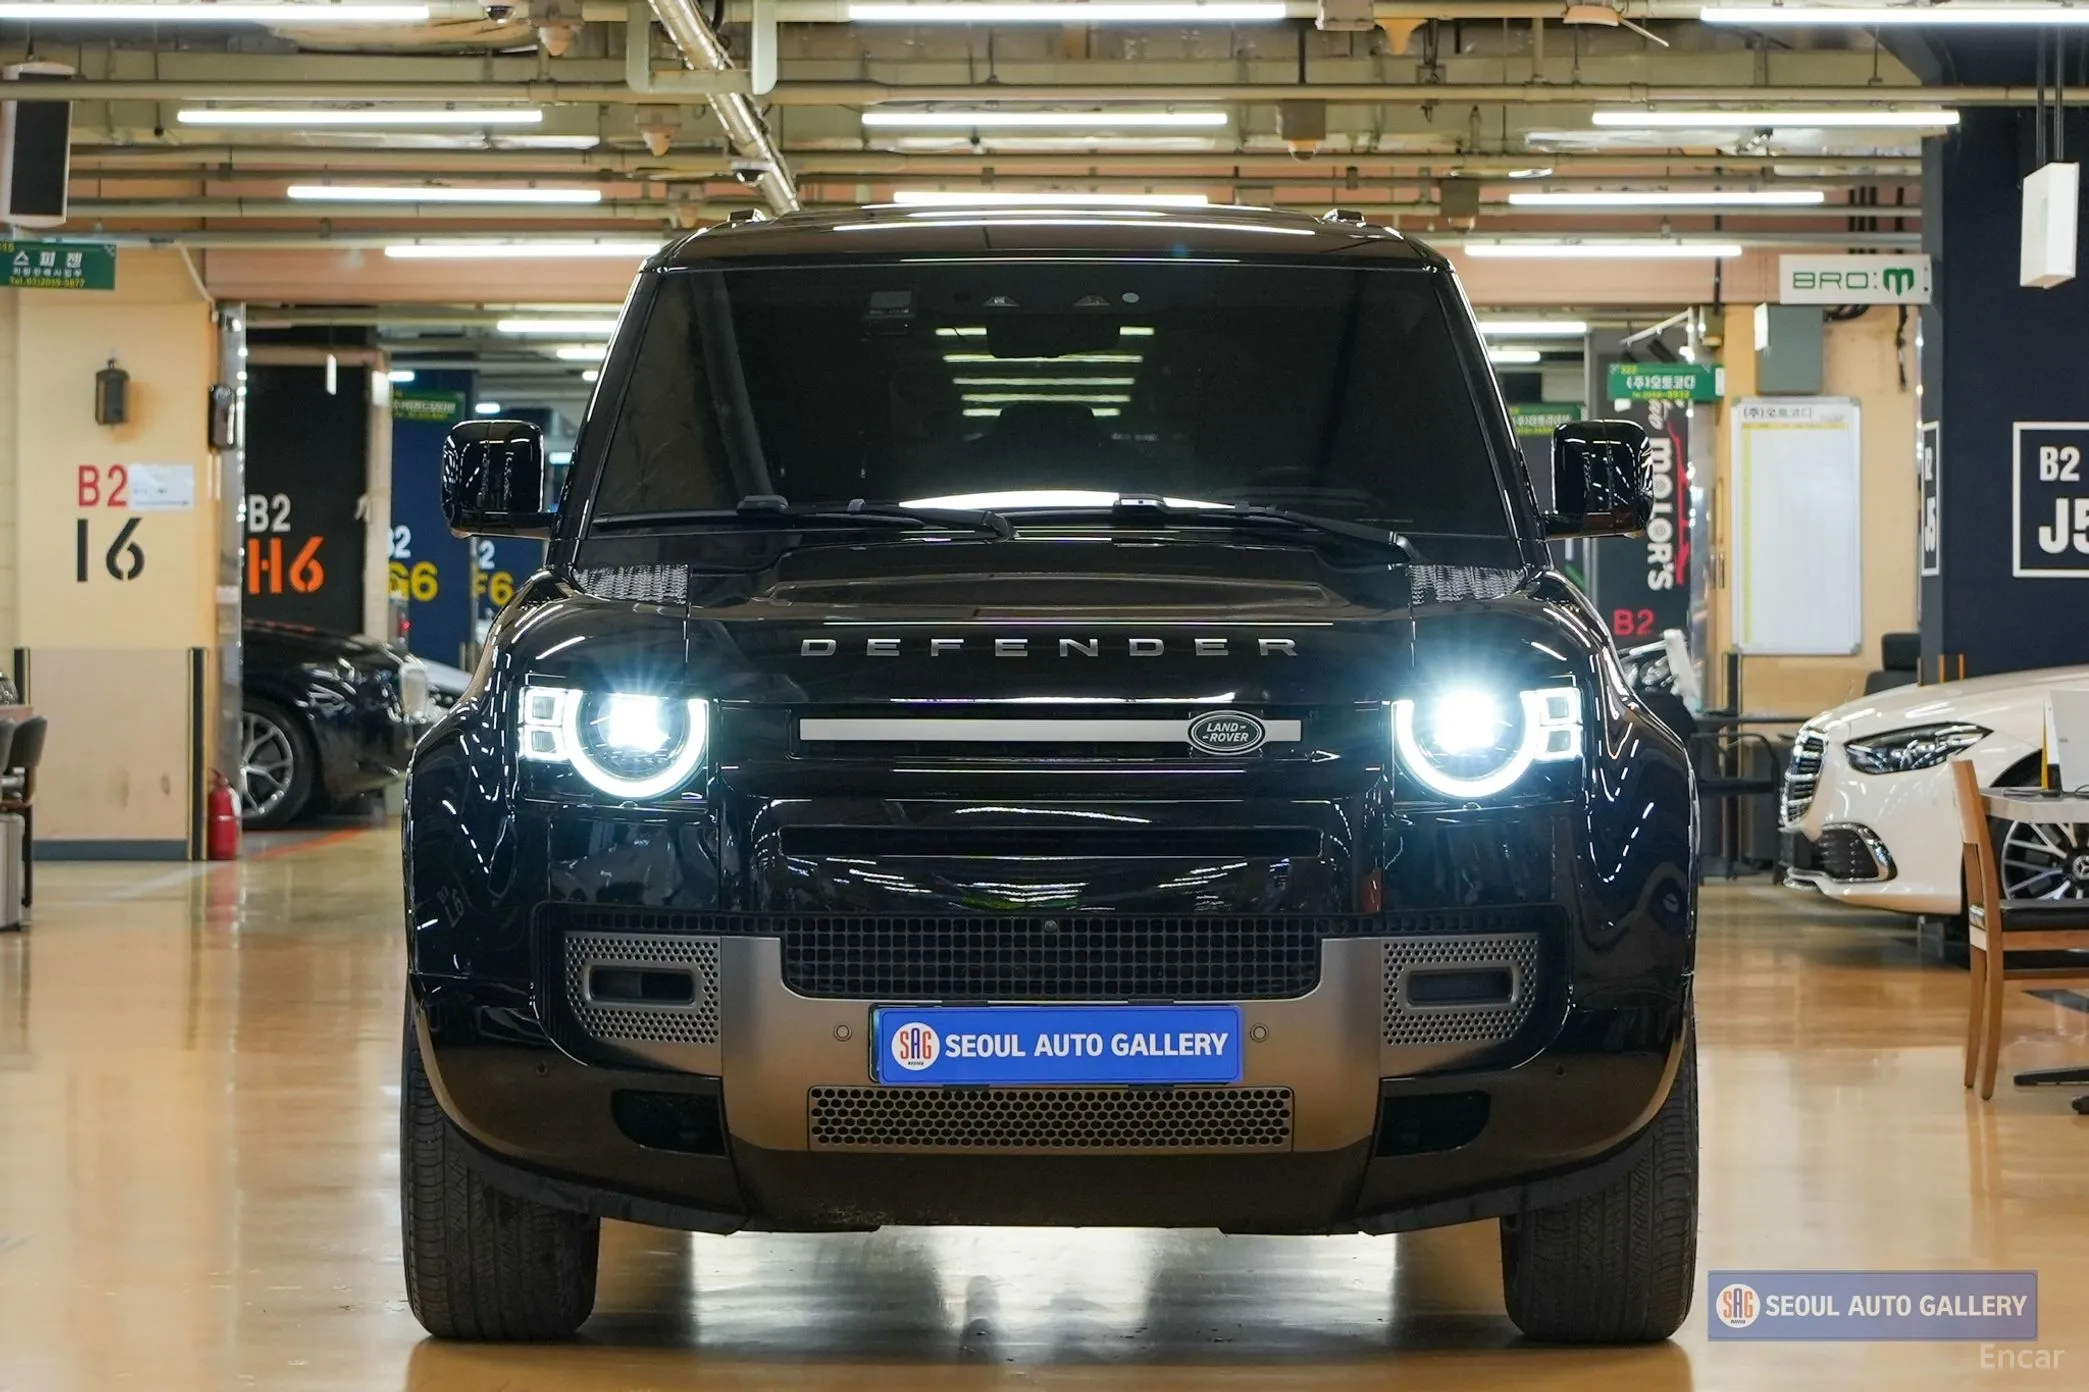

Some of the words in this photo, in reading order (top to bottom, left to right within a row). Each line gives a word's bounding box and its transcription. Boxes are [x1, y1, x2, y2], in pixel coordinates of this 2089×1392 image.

[2039, 445, 2080, 481] B2
[77, 464, 129, 508] B2
[248, 493, 291, 533] B2
[248, 536, 325, 595] H6
[1613, 608, 1655, 636] B2
[801, 638, 1298, 657] DEFENDER
[900, 1027, 932, 1060] SAG
[945, 1033, 1026, 1058] SEOUL
[1034, 1032, 1103, 1057] AUTO
[1111, 1032, 1229, 1057] GALLERY
